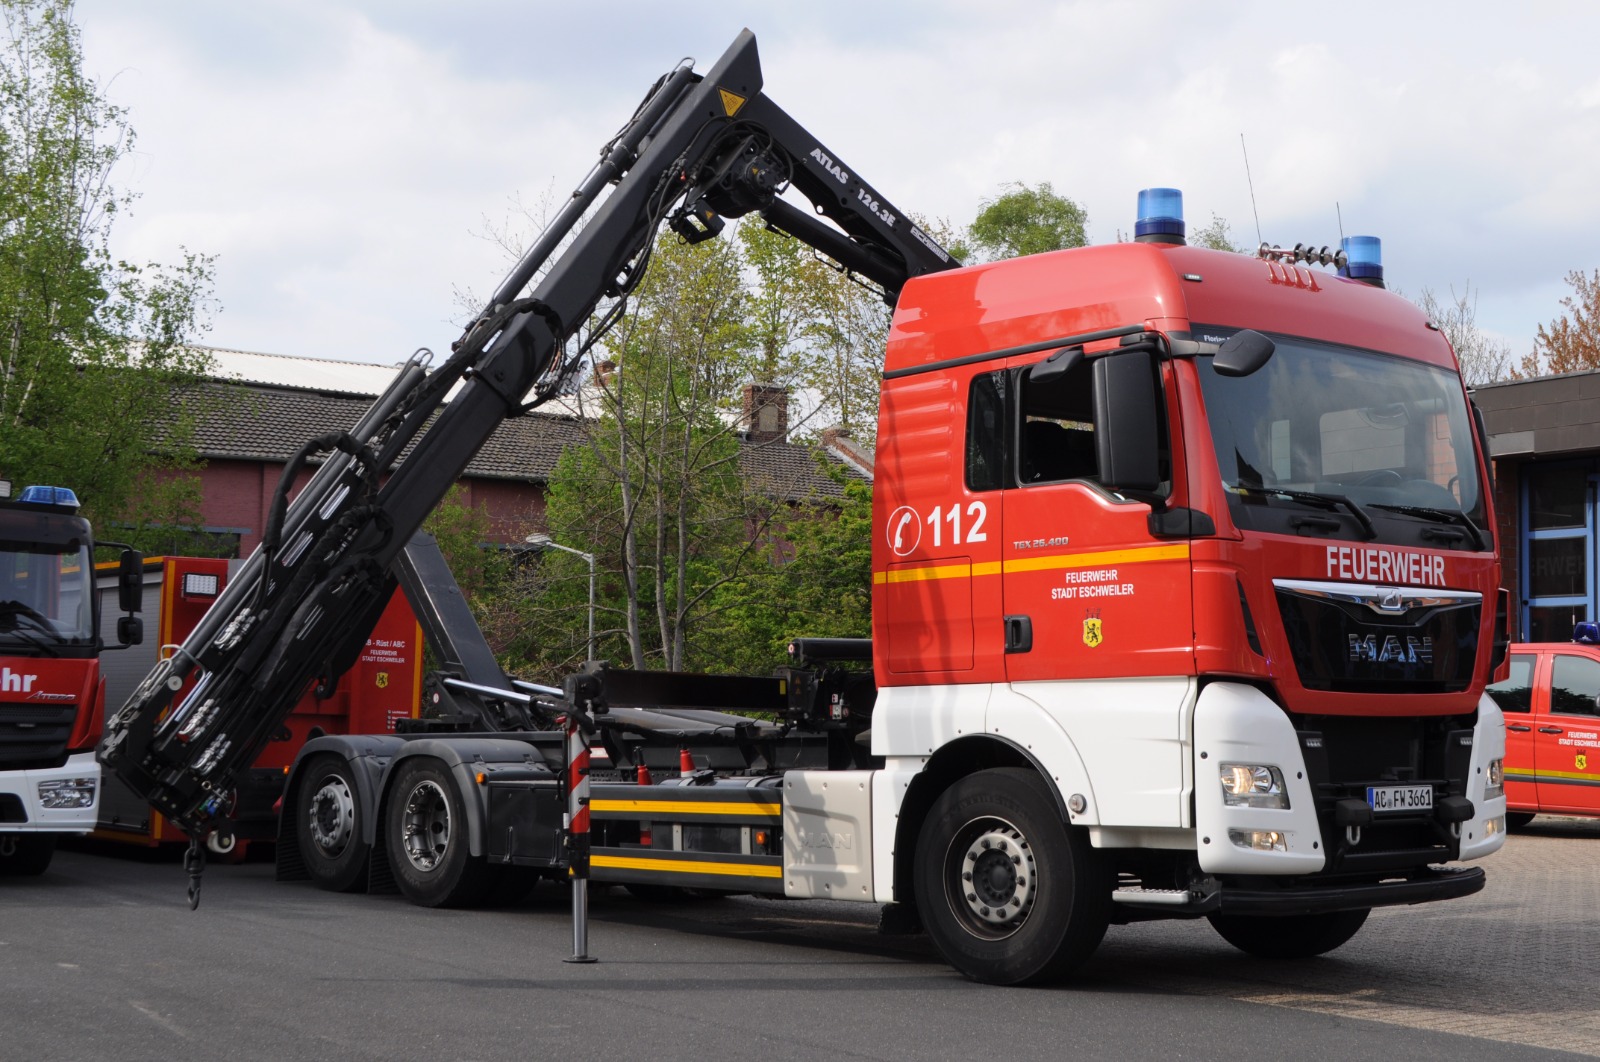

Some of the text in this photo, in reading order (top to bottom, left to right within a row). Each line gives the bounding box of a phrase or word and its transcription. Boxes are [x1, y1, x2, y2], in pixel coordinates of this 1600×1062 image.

[810, 147, 896, 227] ATLAS 126.3E
[927, 500, 987, 547] 112
[1033, 536, 1069, 548] 26.400
[1065, 569, 1118, 583] FEUERWEHR
[1326, 545, 1446, 586] FEUERWEHR
[1051, 583, 1134, 600] STADT ESCHWEILER
[393, 640, 405, 648] ABC
[1348, 633, 1433, 664] MAN
[0, 667, 38, 692] hr
[1374, 789, 1432, 808] AC FW 3661
